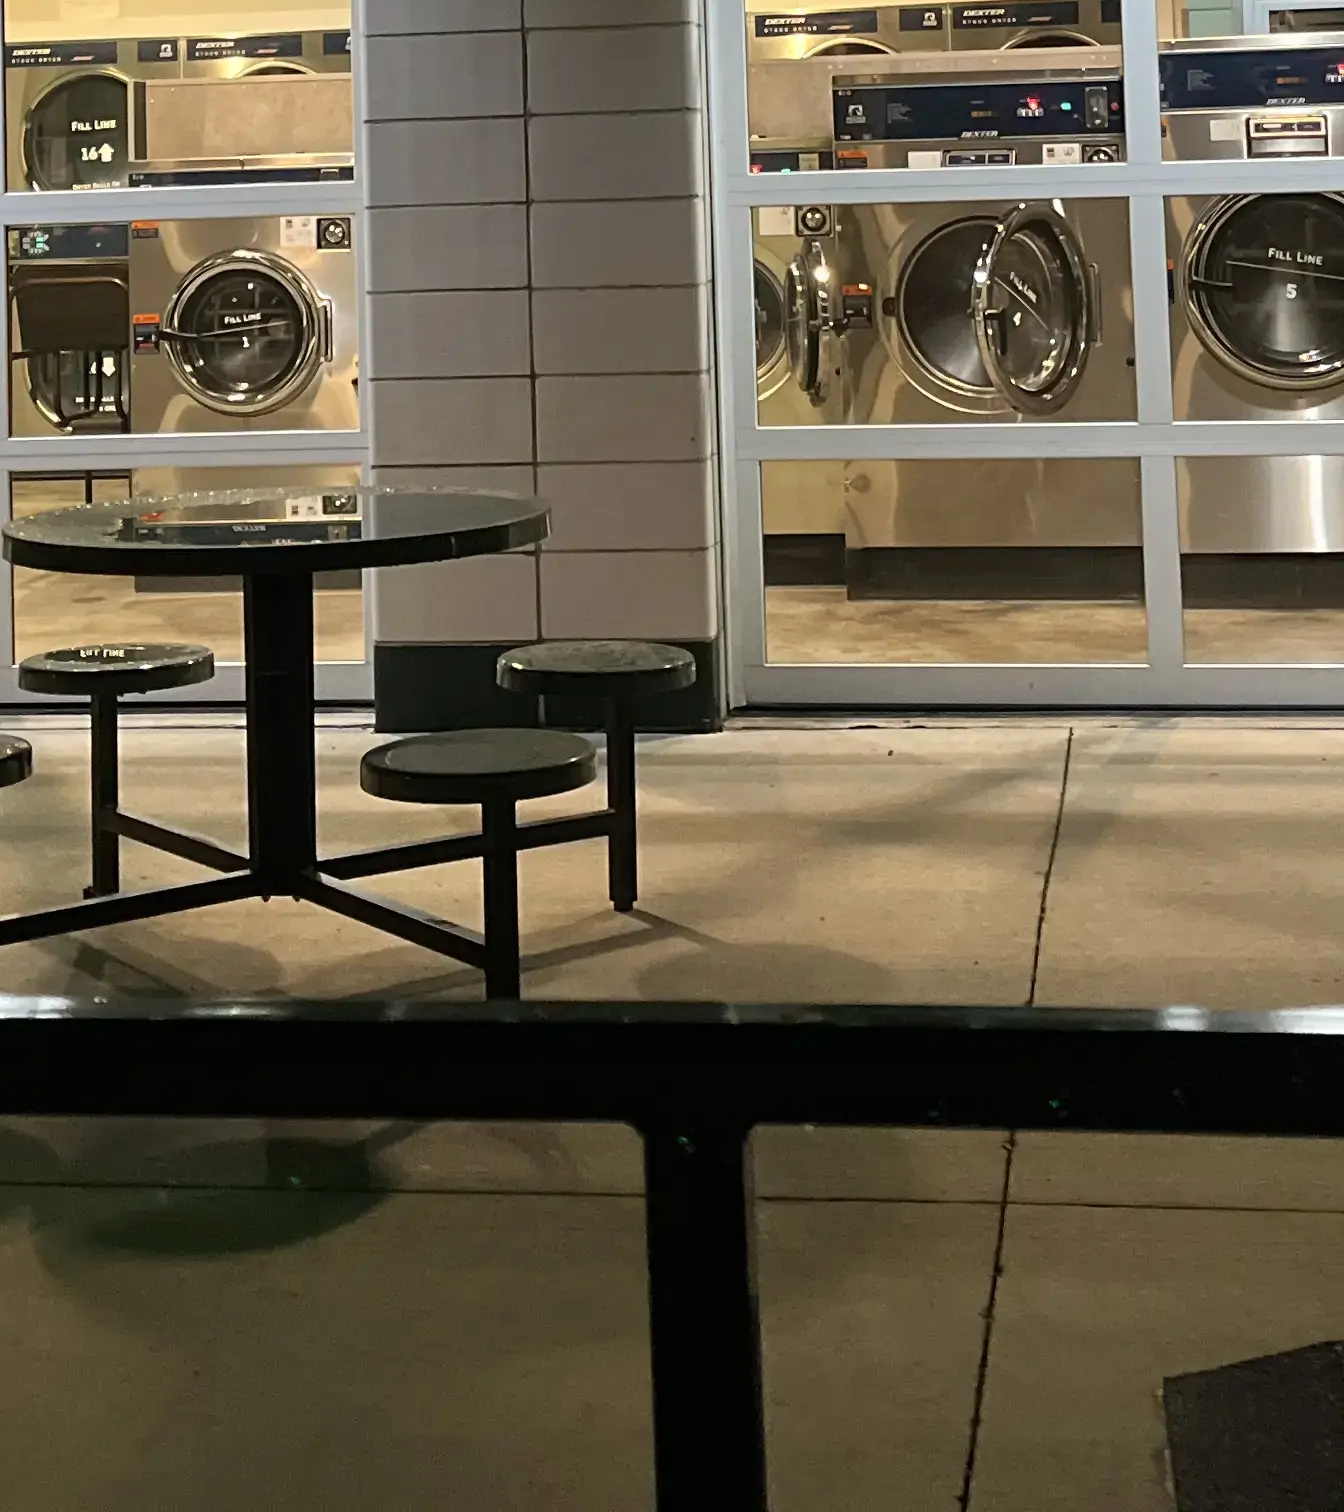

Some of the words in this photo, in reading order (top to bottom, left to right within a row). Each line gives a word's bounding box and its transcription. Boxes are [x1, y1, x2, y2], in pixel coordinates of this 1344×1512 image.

[962, 8, 1005, 18] DEXTER
[71, 120, 93, 132] FILL
[94, 119, 117, 130] LINE
[960, 130, 999, 138] DEXTER
[80, 147, 99, 161] 16
[1268, 247, 1293, 261] FILL
[1296, 251, 1324, 266] LINE
[1286, 283, 1298, 299] 5
[224, 315, 242, 325] FILL
[243, 311, 262, 322] LINE
